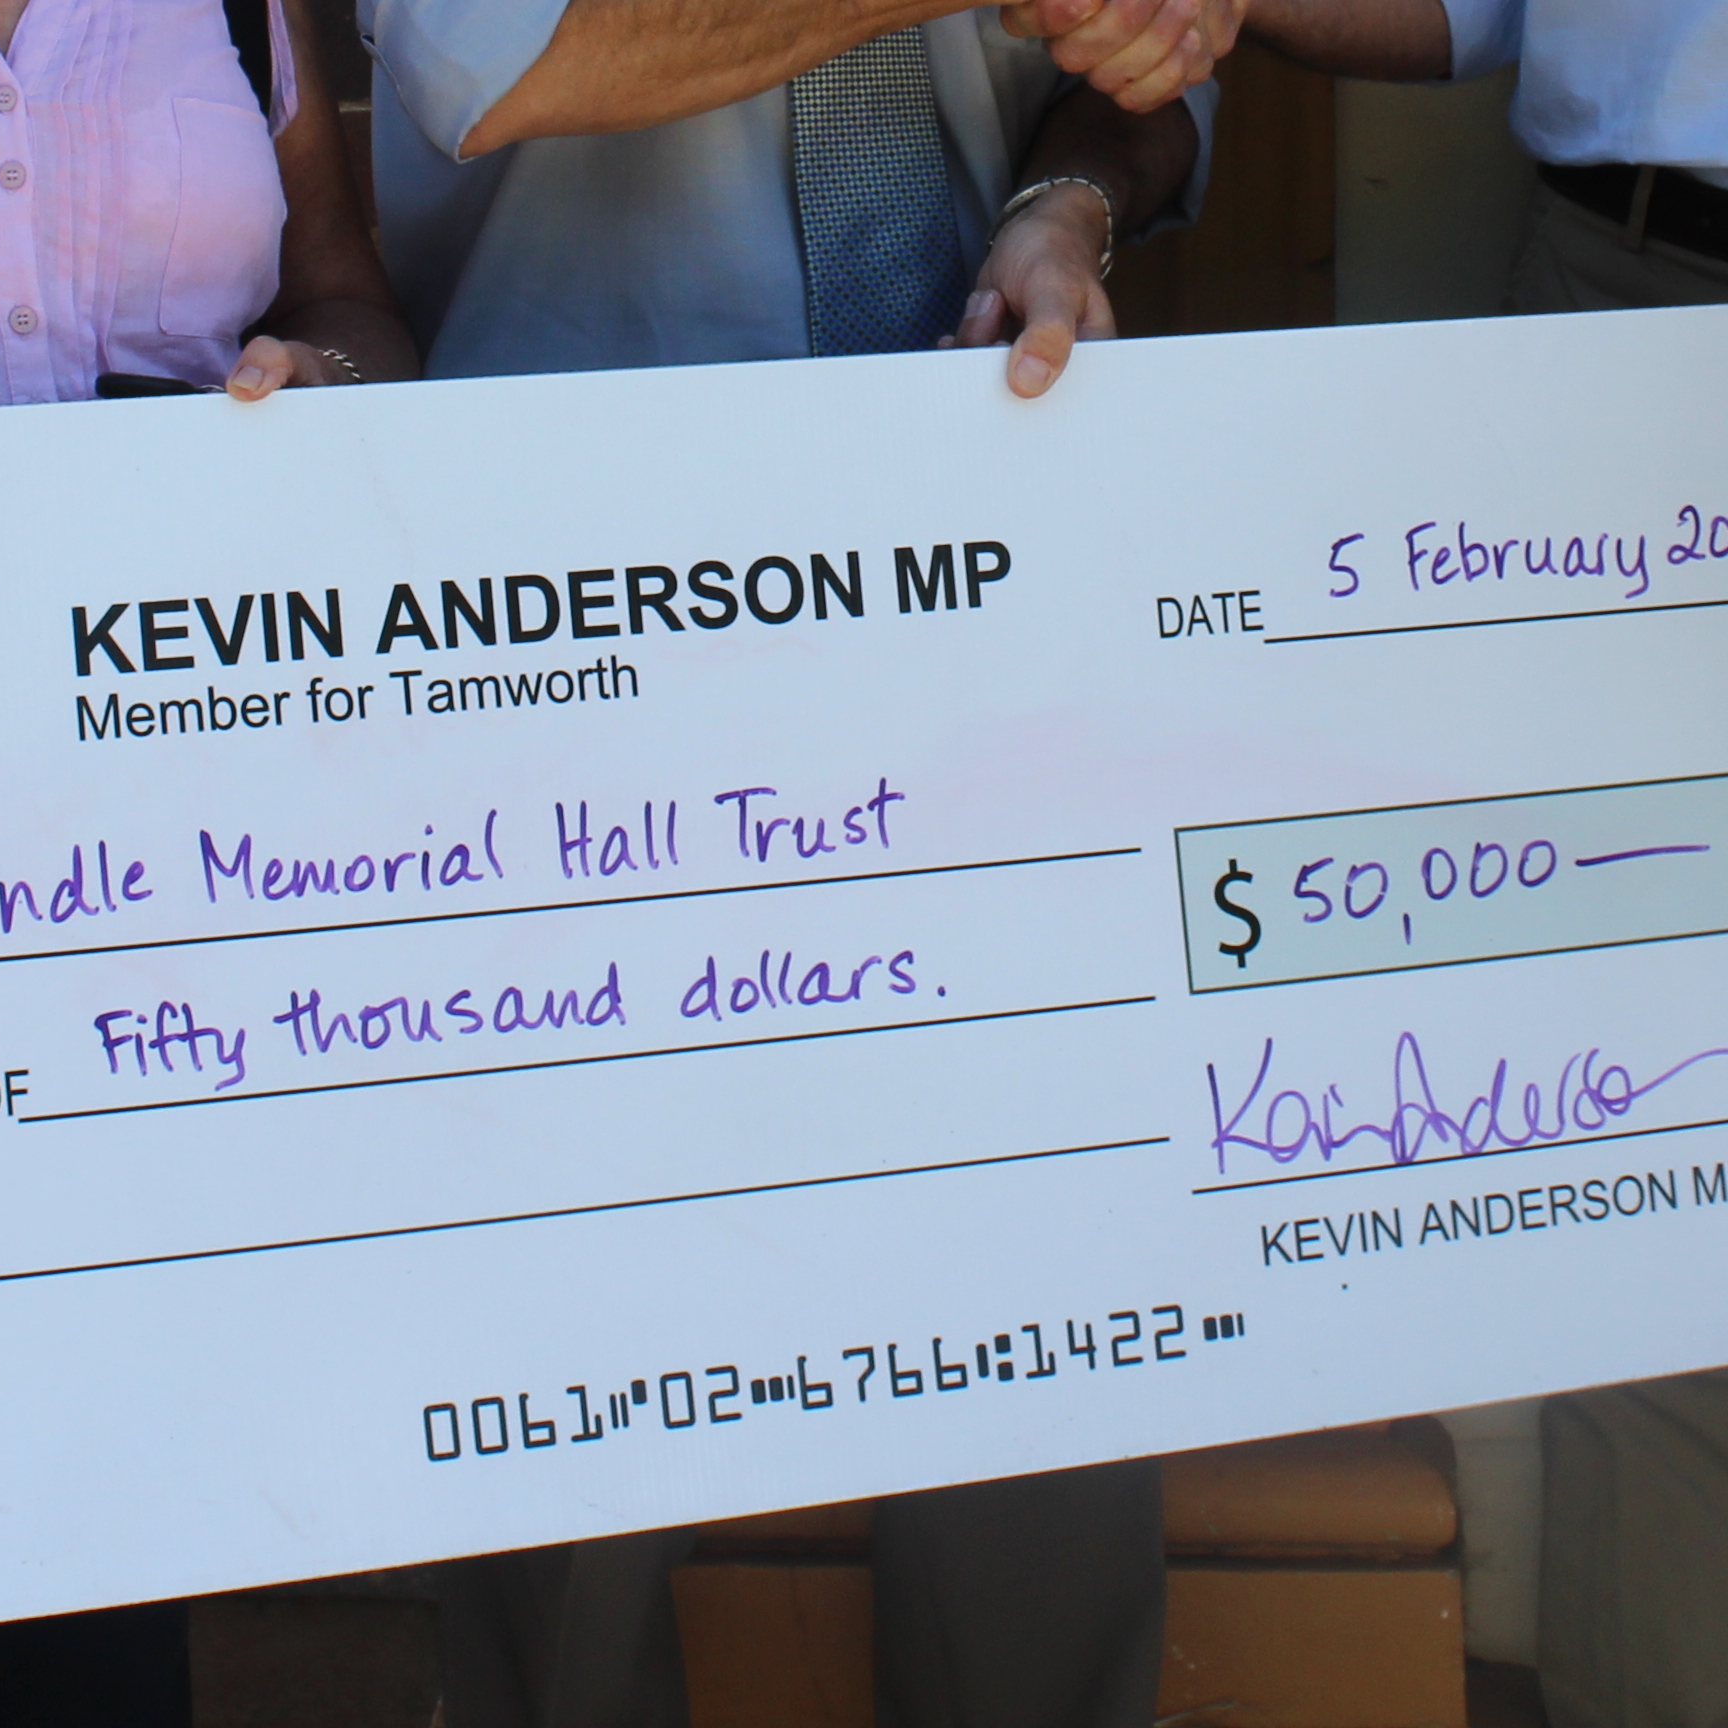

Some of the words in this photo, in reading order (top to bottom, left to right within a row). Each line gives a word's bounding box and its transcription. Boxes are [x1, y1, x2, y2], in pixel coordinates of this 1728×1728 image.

[1328, 532, 1365, 598] 5
[1404, 521, 1650, 599] February
[71, 588, 345, 679] KEVIN
[375, 551, 865, 656] ANDERSON
[893, 540, 1012, 615] MP
[1156, 589, 1265, 640] DATE
[75, 685, 291, 743] Member
[305, 676, 375, 724] for
[388, 654, 639, 717] Tamworth
[198, 808, 504, 904] Memorial
[554, 800, 678, 879] Hall
[713, 777, 906, 863] Trust
[92, 1000, 246, 1092] Fifty
[272, 961, 624, 1057] thousand
[680, 949, 947, 1022] dollars.
[1260, 1207, 1404, 1268] KEVIN
[1419, 1170, 1679, 1246] ANDERSON
